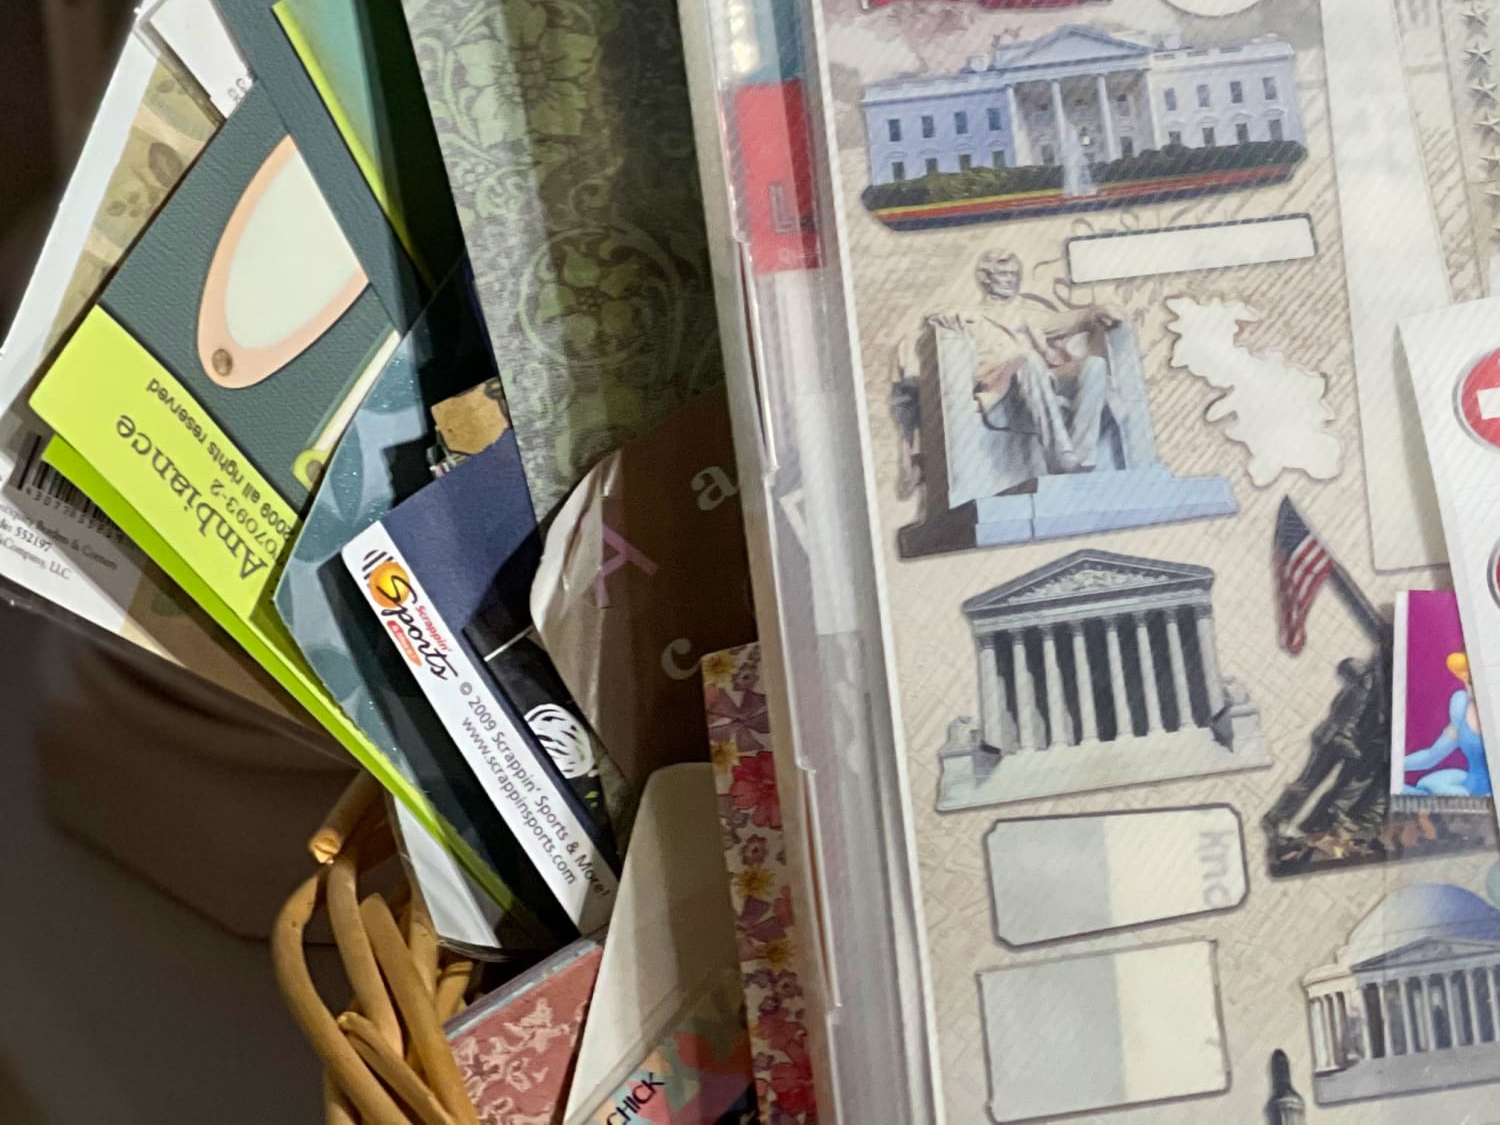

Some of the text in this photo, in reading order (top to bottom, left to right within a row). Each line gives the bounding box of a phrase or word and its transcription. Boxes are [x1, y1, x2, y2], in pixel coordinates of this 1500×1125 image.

[145, 378, 208, 443] reserved
[207, 441, 244, 485] rights
[116, 415, 268, 580] Ambiance
[242, 483, 261, 503] all
[15, 527, 53, 553] 552197
[50, 561, 73, 580] LLC
[376, 575, 459, 681] Sports
[416, 605, 453, 652] Scrappin'
[462, 716, 577, 885] www.scrappinsports.com
[468, 696, 497, 731] 2009
[491, 731, 541, 792] Scrappin'
[534, 794, 569, 841] Sports
[566, 841, 580, 856] &
